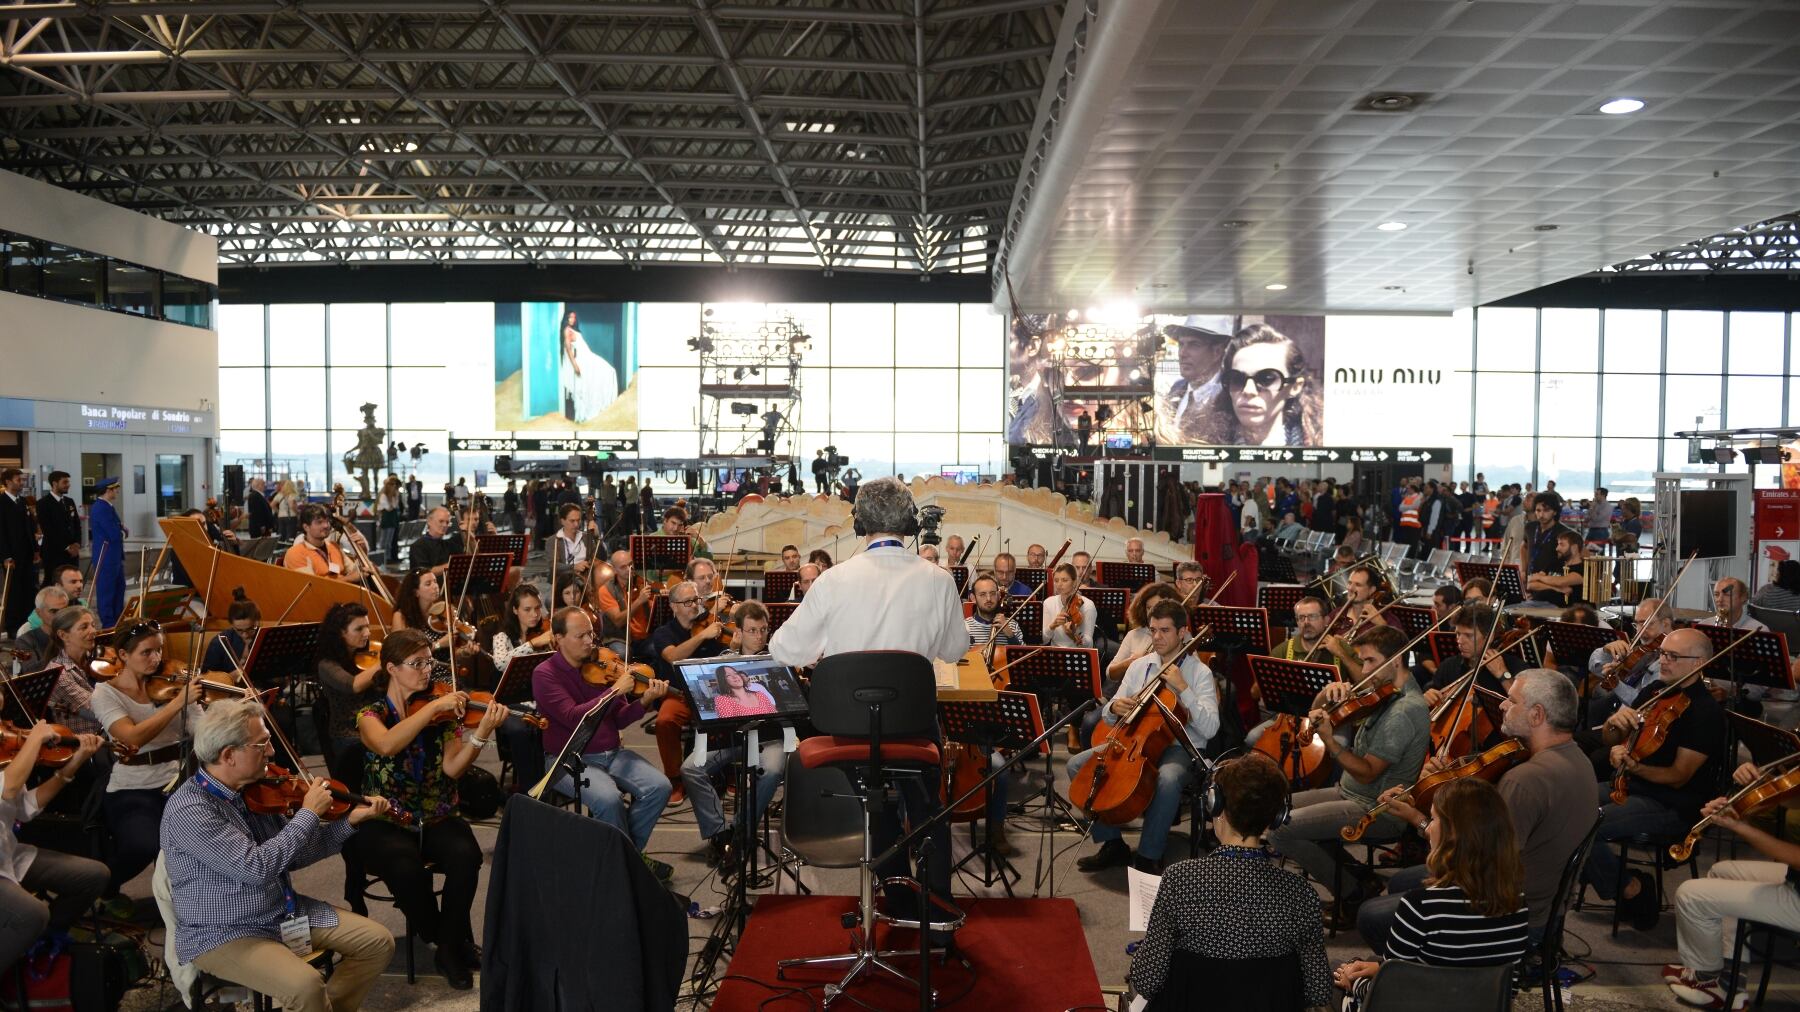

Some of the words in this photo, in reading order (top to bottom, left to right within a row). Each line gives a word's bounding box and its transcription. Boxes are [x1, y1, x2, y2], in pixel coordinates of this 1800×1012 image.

[81, 404, 107, 418] Banca
[111, 407, 147, 420] Popolare
[151, 409, 160, 420] di
[162, 410, 190, 423] Sondrio
[490, 440, 518, 450] 20-24
[562, 440, 580, 450] 1-17
[1263, 450, 1283, 460] 1-17
[1761, 490, 1790, 498] Emirates
